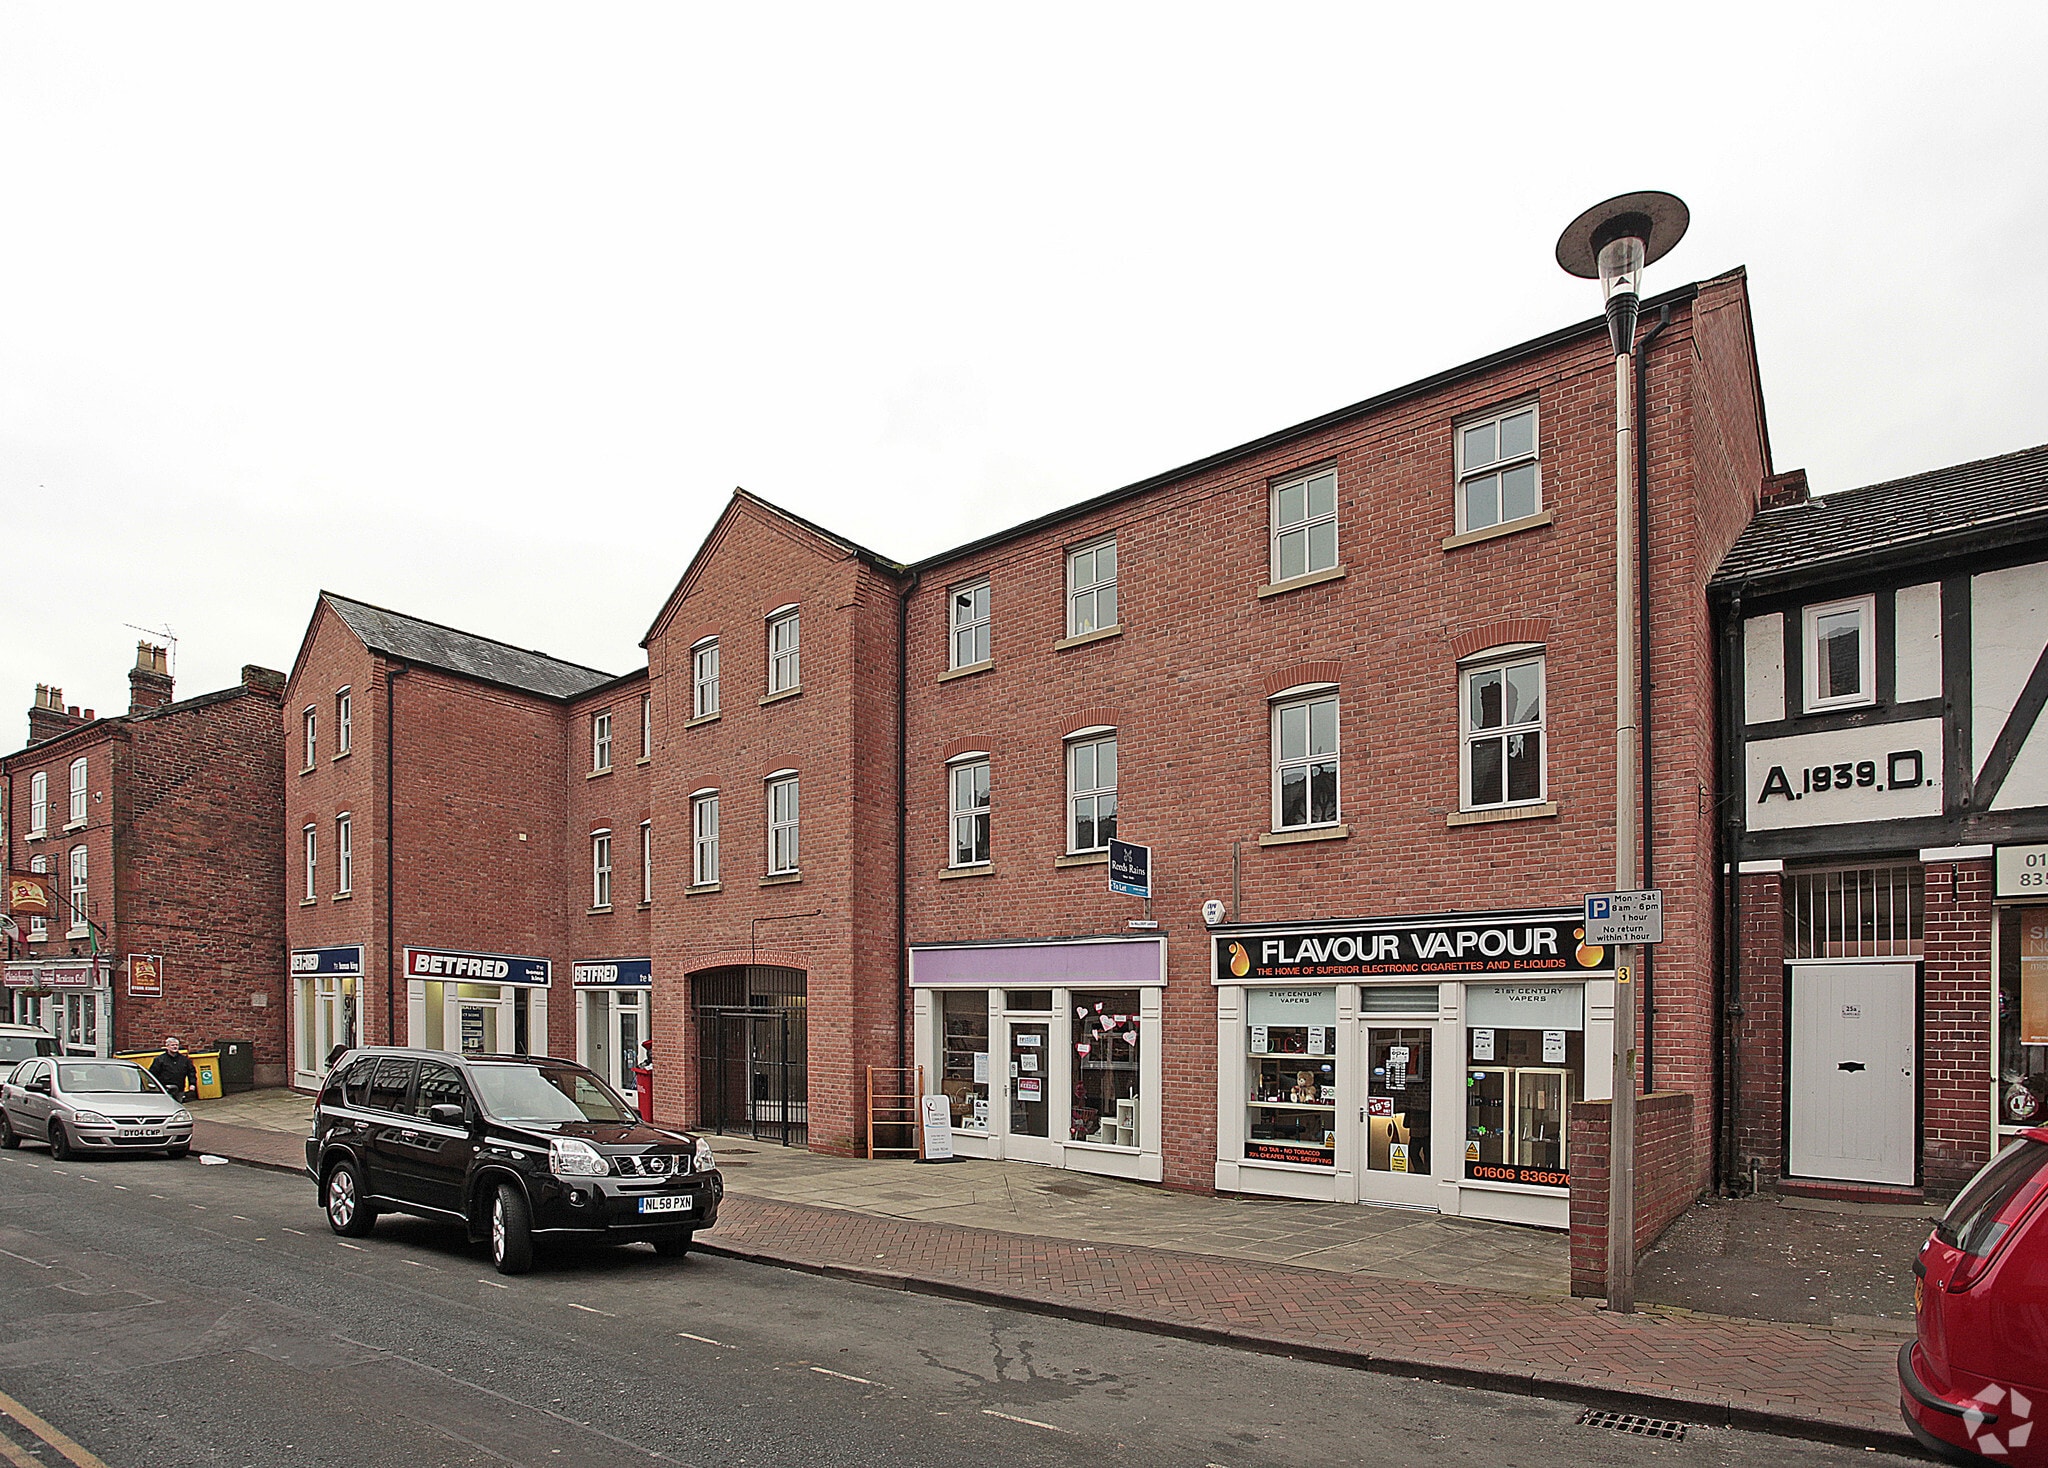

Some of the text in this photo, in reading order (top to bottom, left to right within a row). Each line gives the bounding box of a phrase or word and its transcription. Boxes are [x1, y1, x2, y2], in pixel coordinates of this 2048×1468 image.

[1111, 860, 1146, 876] Reeds Rains
[2020, 872, 2048, 887] 83
[1112, 882, 1119, 890] To
[1119, 884, 1127, 892] Let
[1640, 893, 1656, 901] Sat
[1593, 900, 1607, 918] P
[1611, 904, 1631, 912] 8am
[1639, 903, 1659, 911] 6pm
[1262, 927, 1558, 964] FLAVOUR VAPOUR
[414, 954, 509, 978] BETFRED
[525, 968, 544, 977] bonus
[1256, 958, 1567, 976] THE HOME OF SUPERIOR ELECTRONIC CIGARETTES AND E-LIQUIDS
[531, 975, 544, 983] king
[574, 964, 618, 983] BETFRED
[1618, 967, 1628, 981] 3
[1260, 1152, 1285, 1160] CHEAPER
[1300, 1156, 1332, 1164] SATISFYING
[1293, 1148, 1321, 1157] TOBACCO
[1473, 1165, 1516, 1180] 01606
[645, 1196, 691, 1210] NL58 PXN
